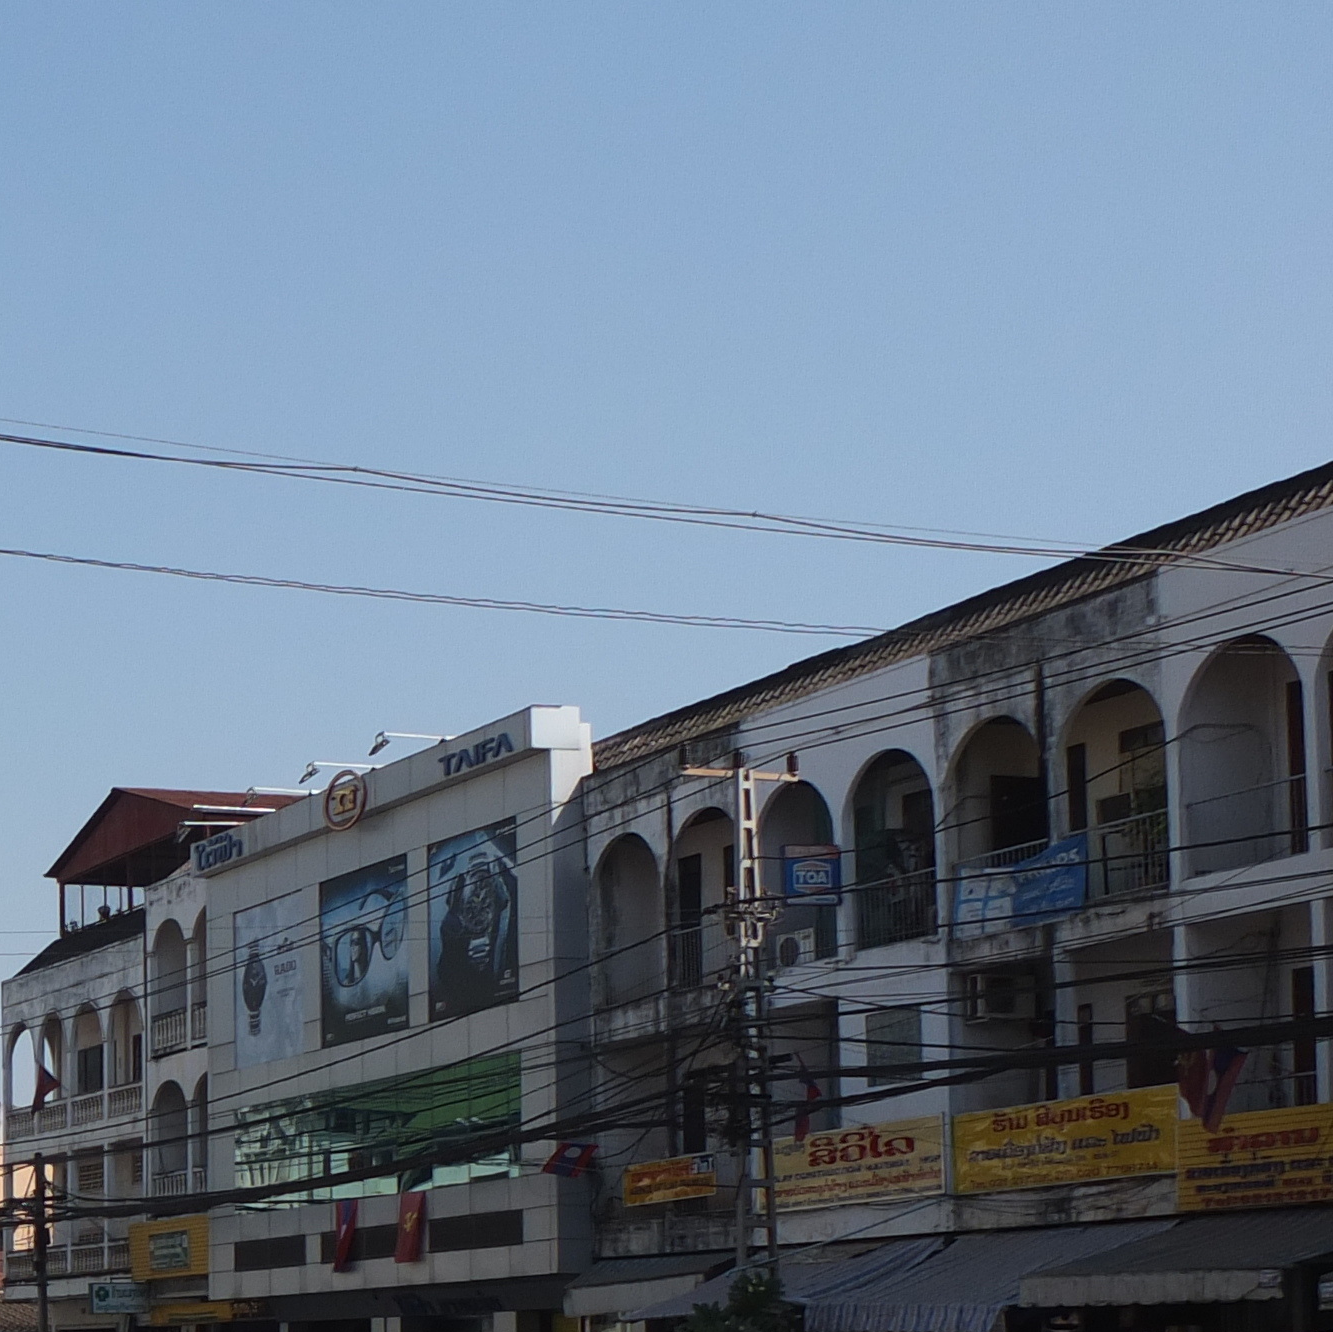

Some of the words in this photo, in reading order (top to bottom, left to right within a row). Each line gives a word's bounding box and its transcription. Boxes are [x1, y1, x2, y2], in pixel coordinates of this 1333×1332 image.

[438, 732, 515, 777] TAIFA
[795, 870, 827, 885] TOA
[273, 959, 298, 976] RADO
